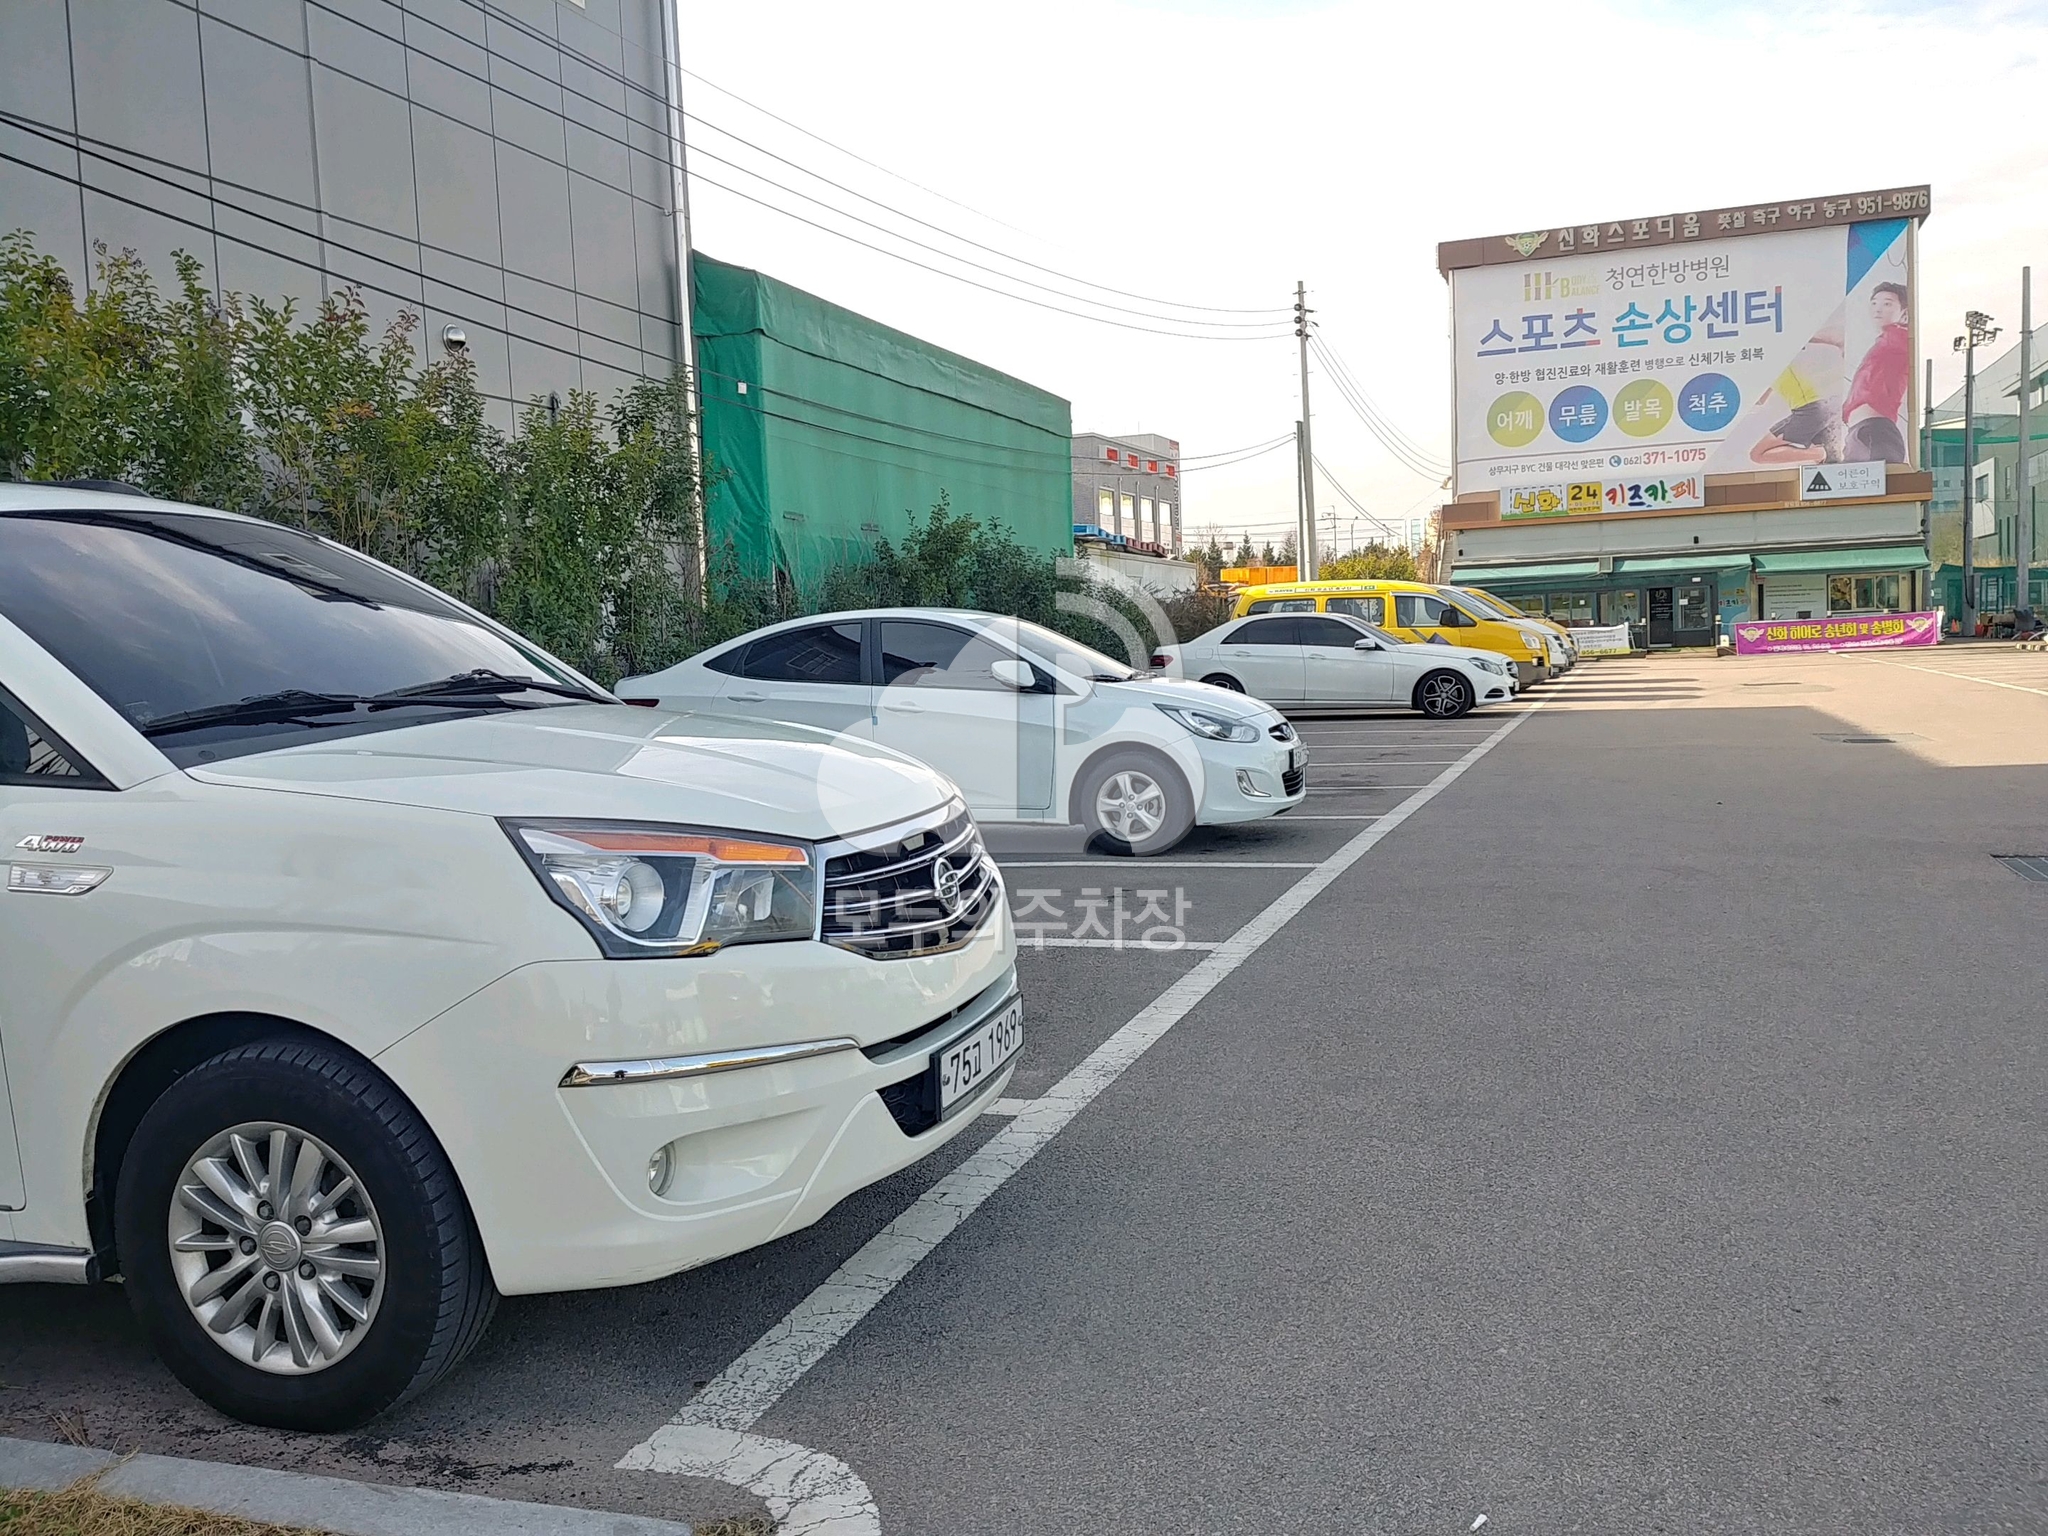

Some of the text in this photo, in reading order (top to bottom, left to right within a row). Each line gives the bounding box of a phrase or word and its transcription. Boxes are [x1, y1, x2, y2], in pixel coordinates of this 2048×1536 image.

[1558, 190, 1928, 251] 신화스포디움 풋살 축구 야구 농구 951-9876
[1605, 255, 1729, 290] 청연한방병원
[1477, 308, 1600, 357] 스포츠
[1535, 364, 1590, 382] 협진진료와
[1595, 359, 1641, 376] 재활훈련
[1644, 356, 1685, 371] 병행으로
[1688, 351, 1736, 366] 신체기능
[1740, 347, 1764, 362] 회복
[1624, 399, 1663, 421] 발목
[1688, 393, 1728, 415] 척추
[1497, 411, 1532, 431] 어깨
[1558, 405, 1597, 427] 무릎
[1489, 465, 1520, 476] 상무지구
[1521, 464, 1536, 472] BYC
[1538, 462, 1553, 472] 건물
[1555, 460, 1579, 470] 대각선
[1513, 477, 1699, 513] 신화 24 키즈카페
[1838, 478, 1880, 490] 보호구역
[1766, 627, 1787, 641] 신화
[1790, 624, 1822, 639] 히어로
[1824, 622, 1856, 638] 송년회
[950, 1040, 981, 1094] 75고
[988, 1009, 1017, 1065] 1969
